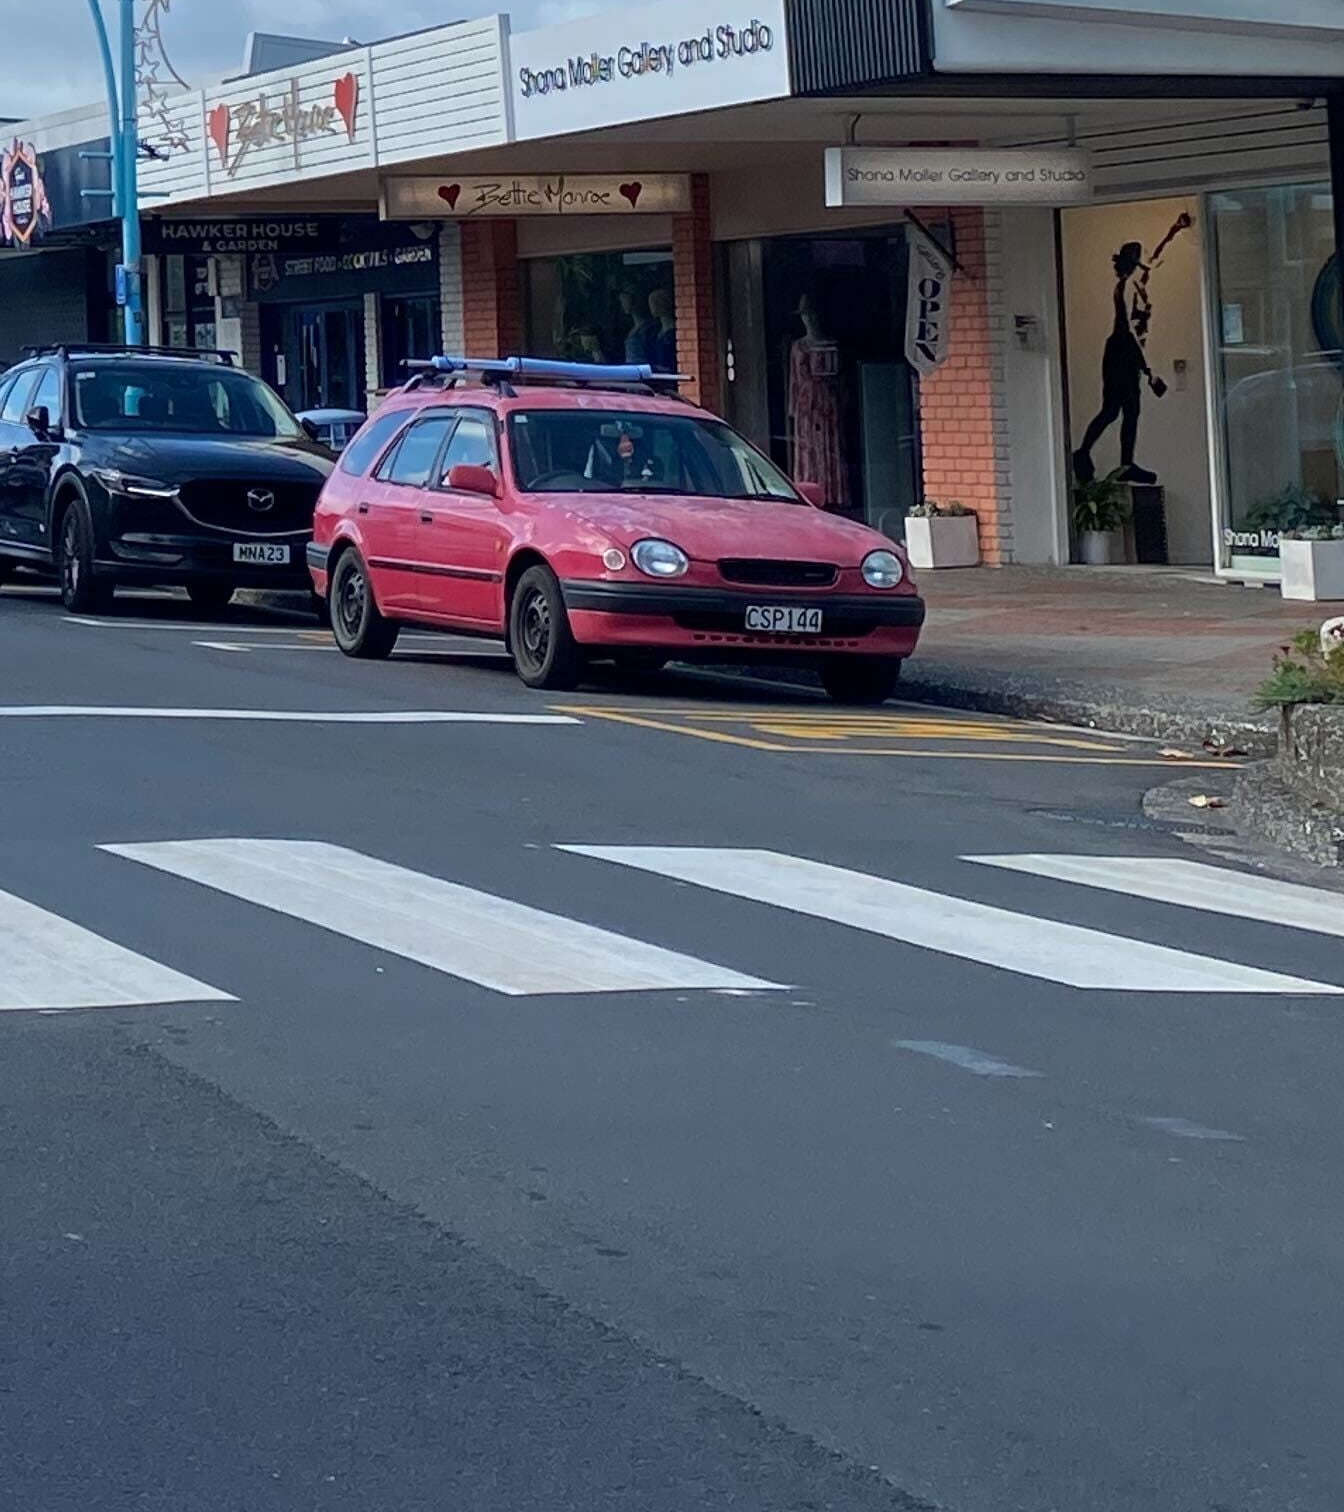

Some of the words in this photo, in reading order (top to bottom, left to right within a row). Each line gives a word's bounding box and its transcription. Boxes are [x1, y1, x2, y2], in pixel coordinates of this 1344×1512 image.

[618, 41, 674, 78] Gallery
[678, 28, 712, 65] and
[716, 18, 774, 57] Studio
[948, 168, 1000, 185] Gallery
[1004, 168, 1035, 183] and
[1039, 168, 1086, 183] Studio
[468, 180, 542, 215] Bettie
[161, 223, 248, 239] HAWKER
[252, 222, 320, 238] HOUSE
[202, 240, 212, 251] &
[216, 239, 278, 251] GARDEN
[914, 278, 941, 362] OPEN
[747, 608, 820, 631] CSP144
